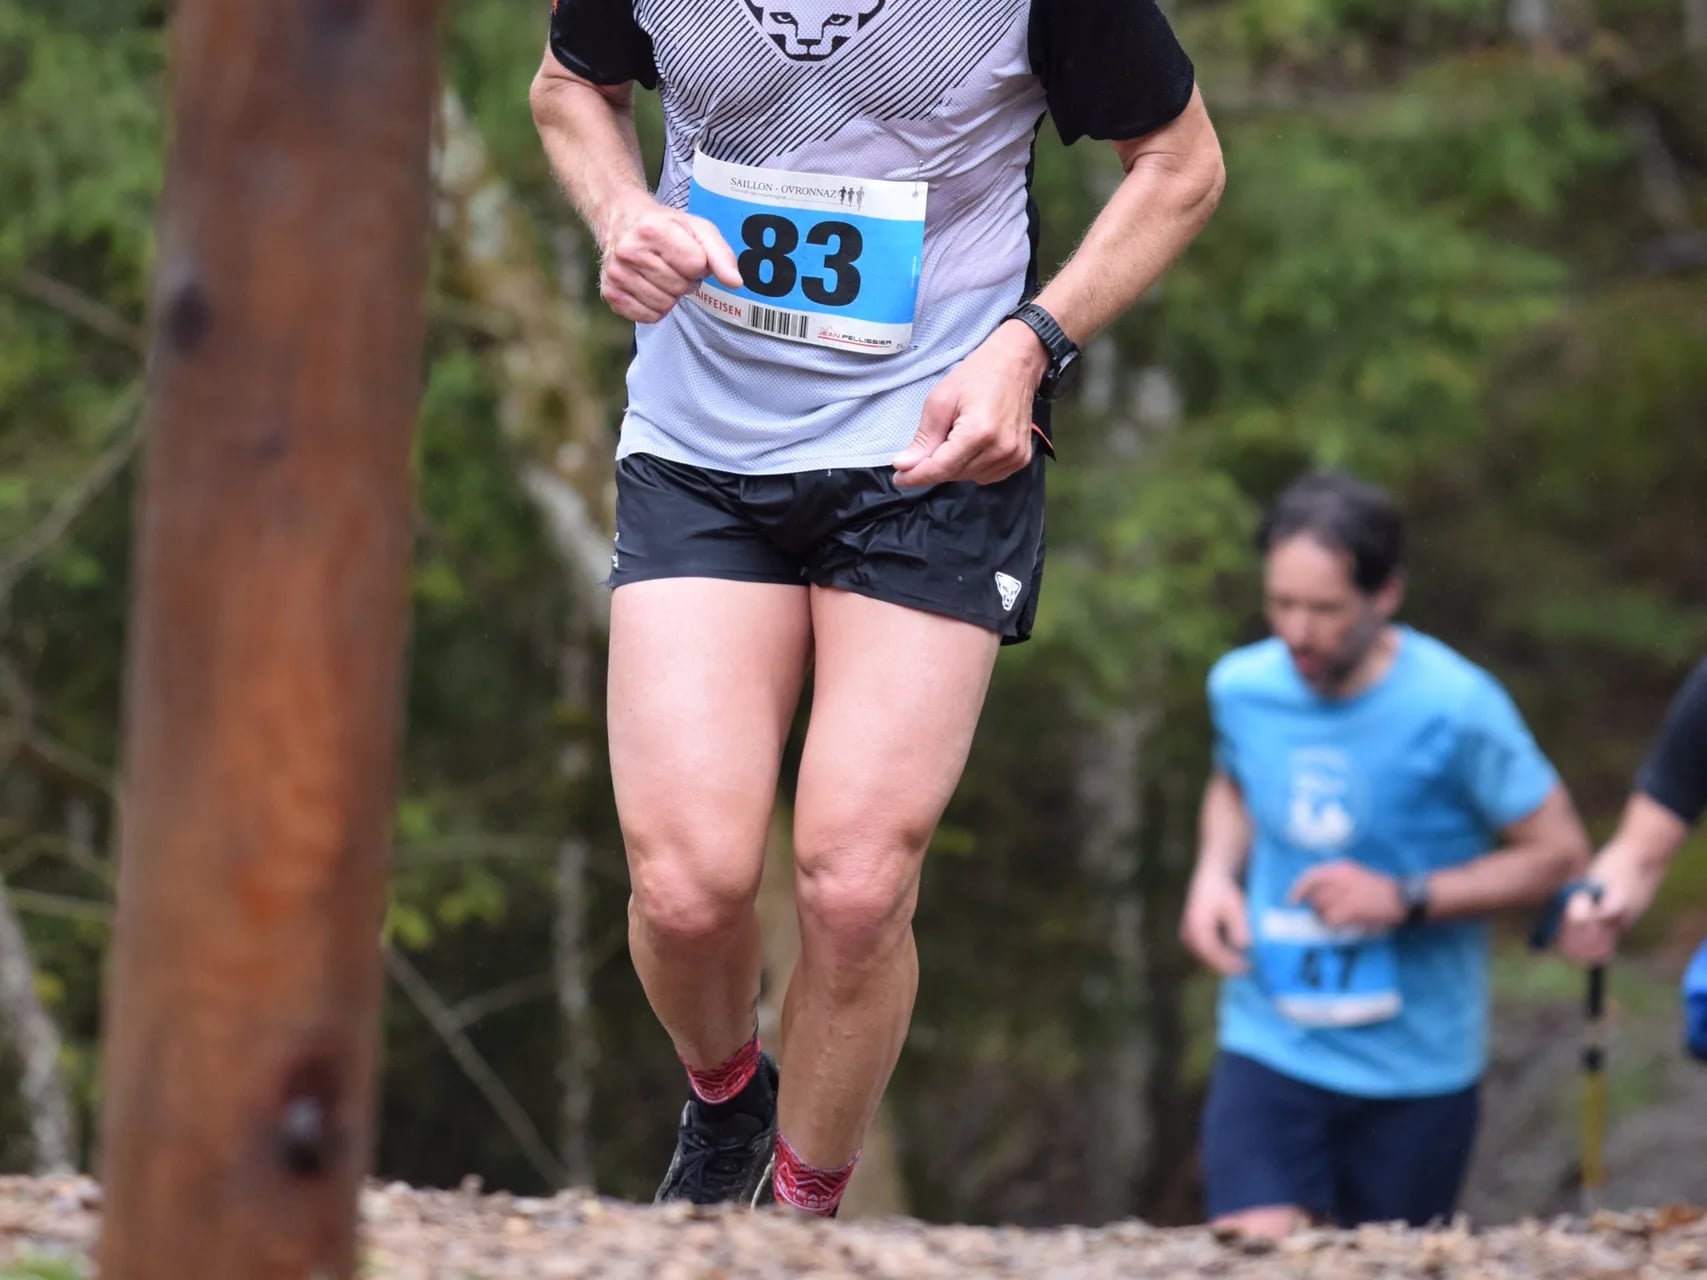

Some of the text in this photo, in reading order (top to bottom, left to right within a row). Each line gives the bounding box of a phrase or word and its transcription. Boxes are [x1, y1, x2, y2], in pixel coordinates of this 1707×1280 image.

[730, 176, 773, 192] SAILLON
[780, 184, 837, 199] OVRONNAZ
[737, 213, 863, 307] 83
[694, 289, 742, 318] AIFFEISEN
